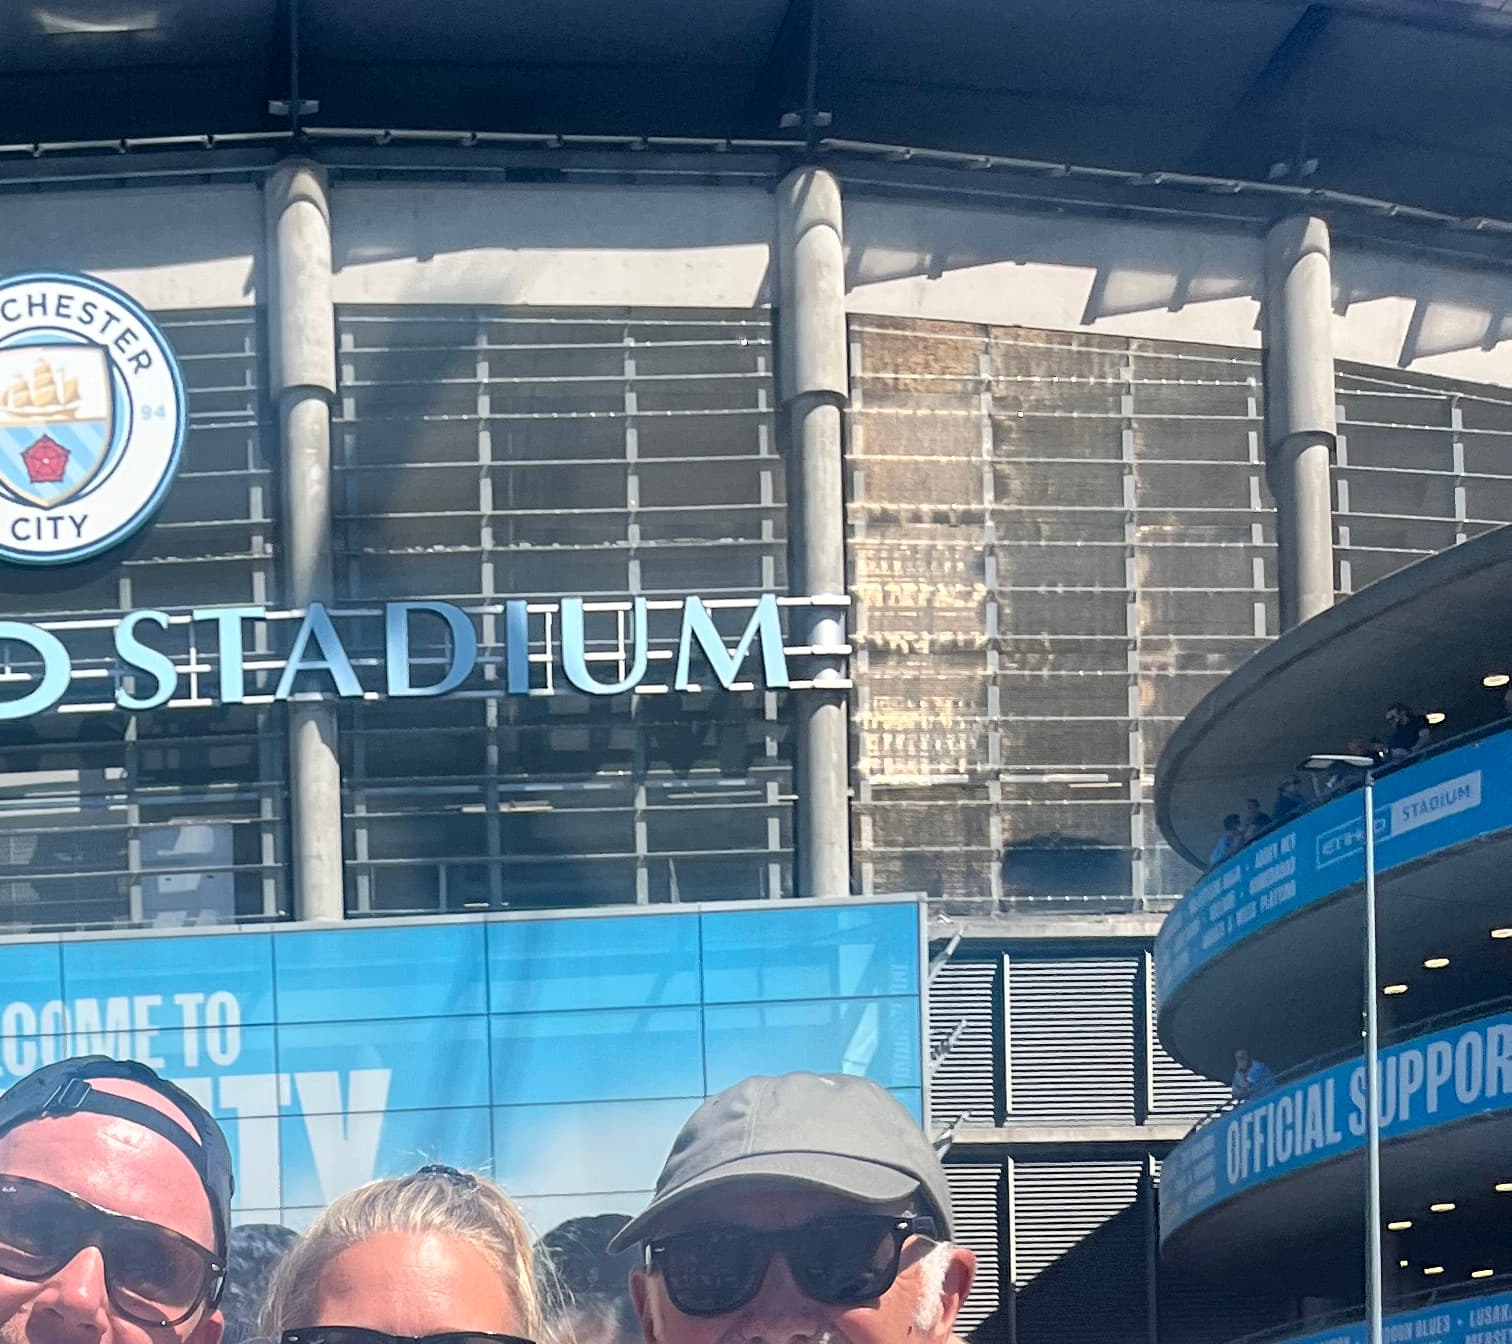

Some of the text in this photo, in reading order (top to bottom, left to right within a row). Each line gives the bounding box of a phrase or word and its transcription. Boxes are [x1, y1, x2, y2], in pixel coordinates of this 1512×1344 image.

[141, 402, 166, 421] 94
[11, 514, 88, 541] CITY
[114, 593, 789, 711] STADIUM
[1402, 784, 1471, 823] STADIUM
[174, 991, 242, 1068] TO
[1226, 1078, 1343, 1185] OFFICIAL
